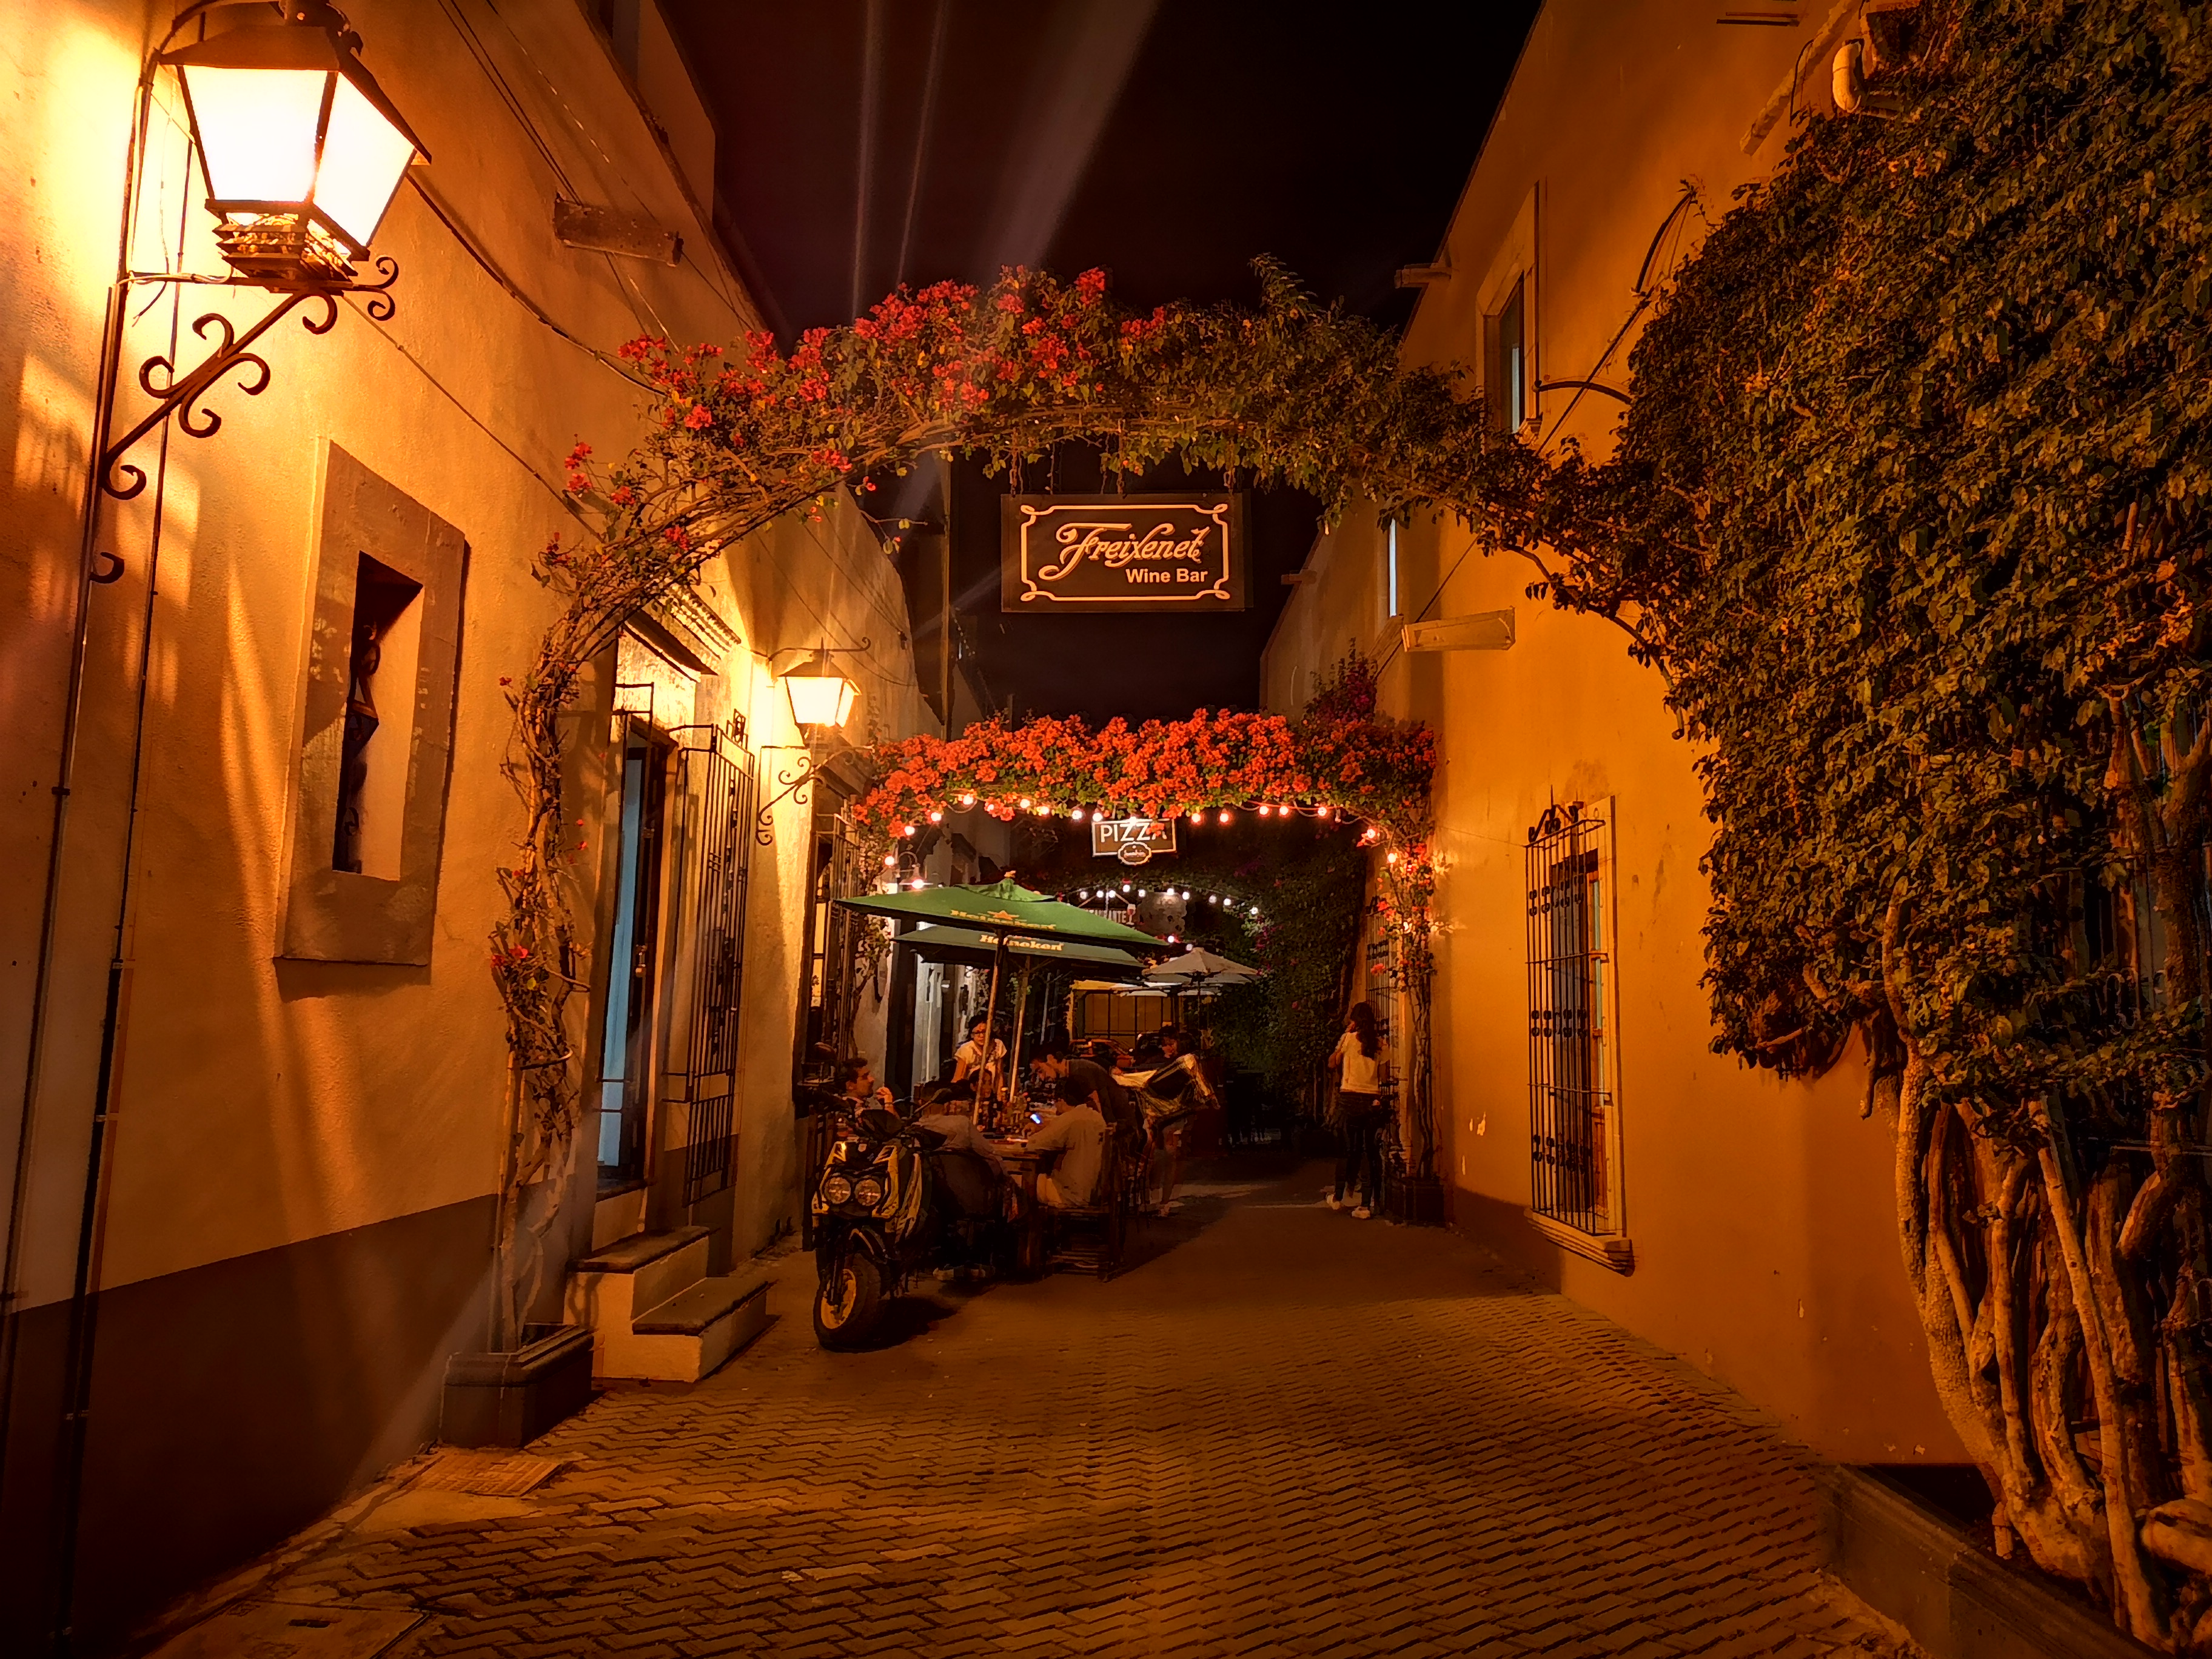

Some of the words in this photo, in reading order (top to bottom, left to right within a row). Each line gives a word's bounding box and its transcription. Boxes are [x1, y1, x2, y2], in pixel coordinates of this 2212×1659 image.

[1039, 523, 1210, 580] Freixenet
[1125, 568, 1171, 583] Wine
[1176, 568, 1208, 583] Bar
